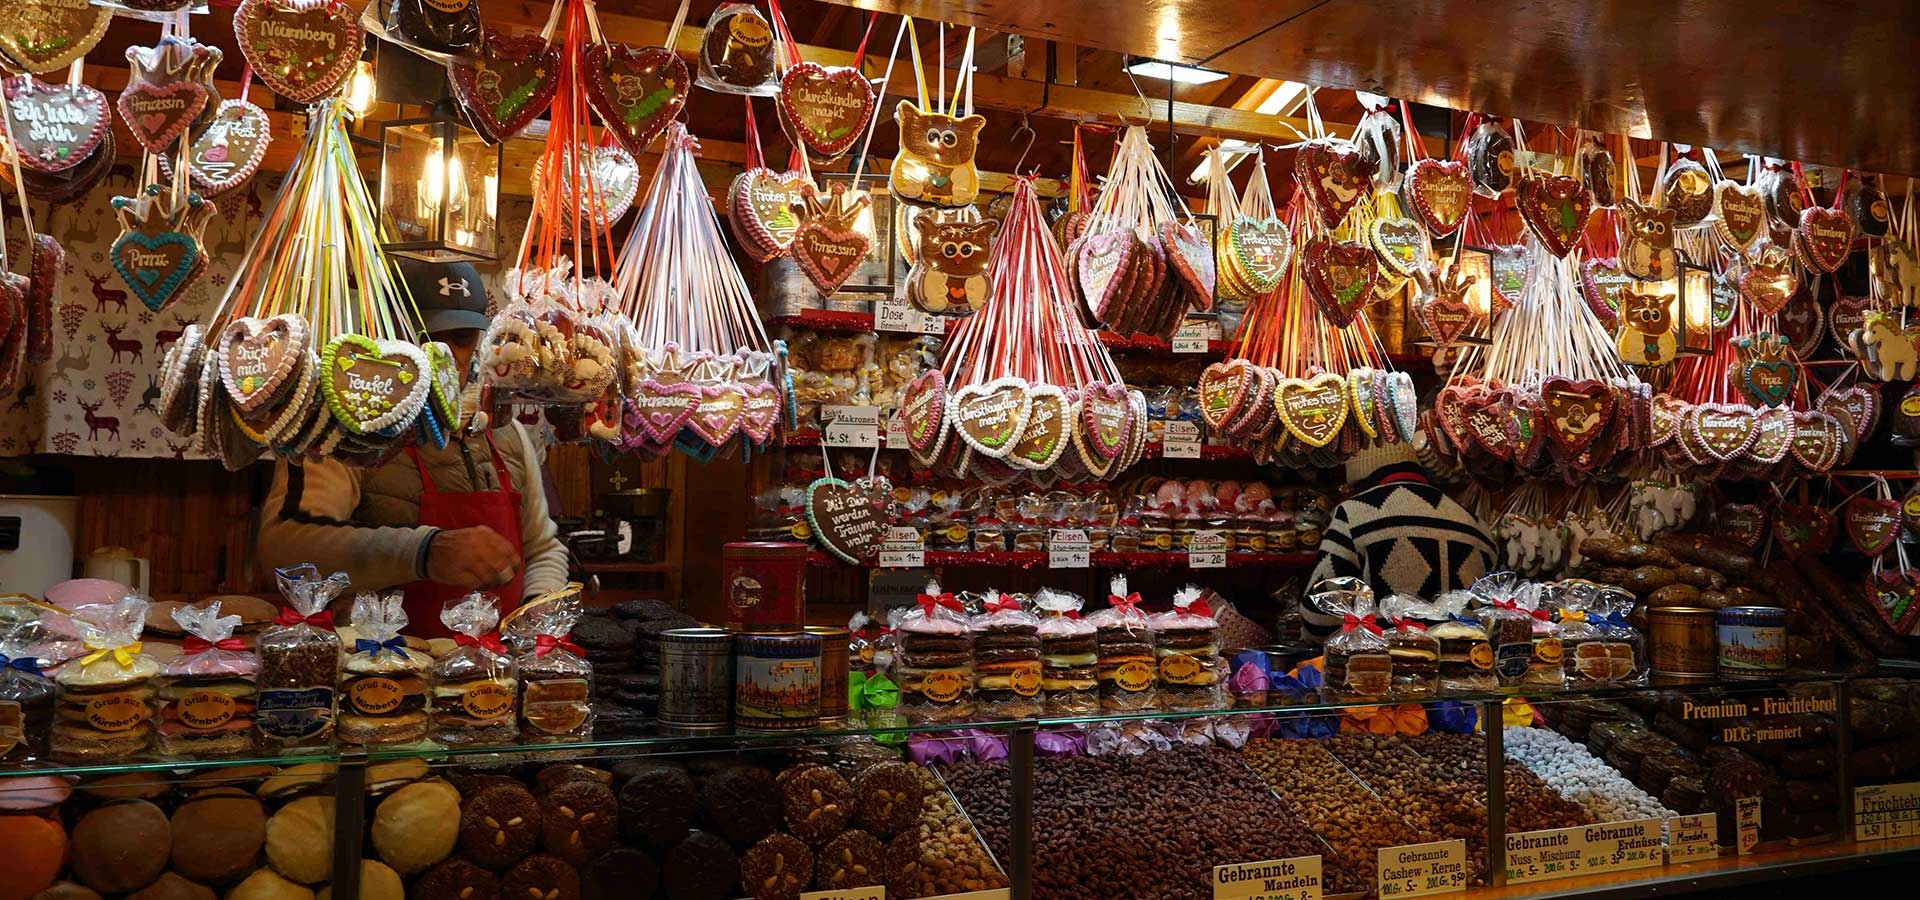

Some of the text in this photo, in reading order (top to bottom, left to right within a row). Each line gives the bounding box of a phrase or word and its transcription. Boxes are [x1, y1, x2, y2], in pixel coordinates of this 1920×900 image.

[430, 0, 463, 9] rnberg
[736, 17, 769, 31] Gruß aus
[261, 20, 336, 49] Nürnberg
[734, 29, 768, 45] Nürnberg
[812, 105, 844, 119] markt
[754, 188, 786, 203] Frohes
[809, 234, 856, 256] Prinzessin
[1267, 233, 1284, 246] Fest
[881, 306, 904, 320] Dose
[237, 361, 268, 376] mich
[347, 372, 394, 396] Teufel
[1759, 371, 1782, 386] Prinz
[1284, 394, 1320, 411] Frohes
[1319, 391, 1342, 405] Fest
[837, 414, 876, 424] Makronen
[1170, 423, 1196, 433] Elisen
[823, 494, 869, 513] Mit Dir
[831, 508, 871, 526] werden
[834, 519, 879, 538] Träume
[1056, 530, 1084, 542] Elisen
[845, 533, 873, 549] wahr
[1194, 533, 1218, 543] Elisen
[1162, 657, 1197, 669] Gruß aus
[927, 672, 961, 686] Gruß aus
[1118, 665, 1150, 681] Gruß aus
[1162, 667, 1198, 684] Nürnberg
[356, 682, 398, 695] Gruß aus
[926, 683, 962, 698] Nürnberg
[1117, 677, 1152, 690] Nürnberg
[469, 687, 507, 698] Gruß aus
[93, 697, 141, 709] Gruß aus
[184, 694, 231, 707] Gruß aus
[355, 695, 398, 711] Nürnberg
[1682, 700, 1748, 720] Premium
[1763, 695, 1838, 716] Früchtebrot
[467, 701, 508, 716] Nürnberg
[90, 711, 141, 730] Nürnberg
[182, 711, 232, 726] Nürnberg
[1585, 824, 1645, 843] Gebrannte
[1676, 829, 1709, 844] Mandeln
[1506, 832, 1568, 851] Gebrannte
[1618, 836, 1662, 851] Erdnüsse
[1398, 849, 1449, 864] Gebrannte
[1510, 854, 1532, 866] Nuss
[1539, 849, 1581, 863] Mischung
[1218, 860, 1296, 884] Gebrannte
[1383, 867, 1422, 881] Cashew
[1431, 862, 1462, 875] Kerne
[1264, 875, 1319, 892] Mandeln
